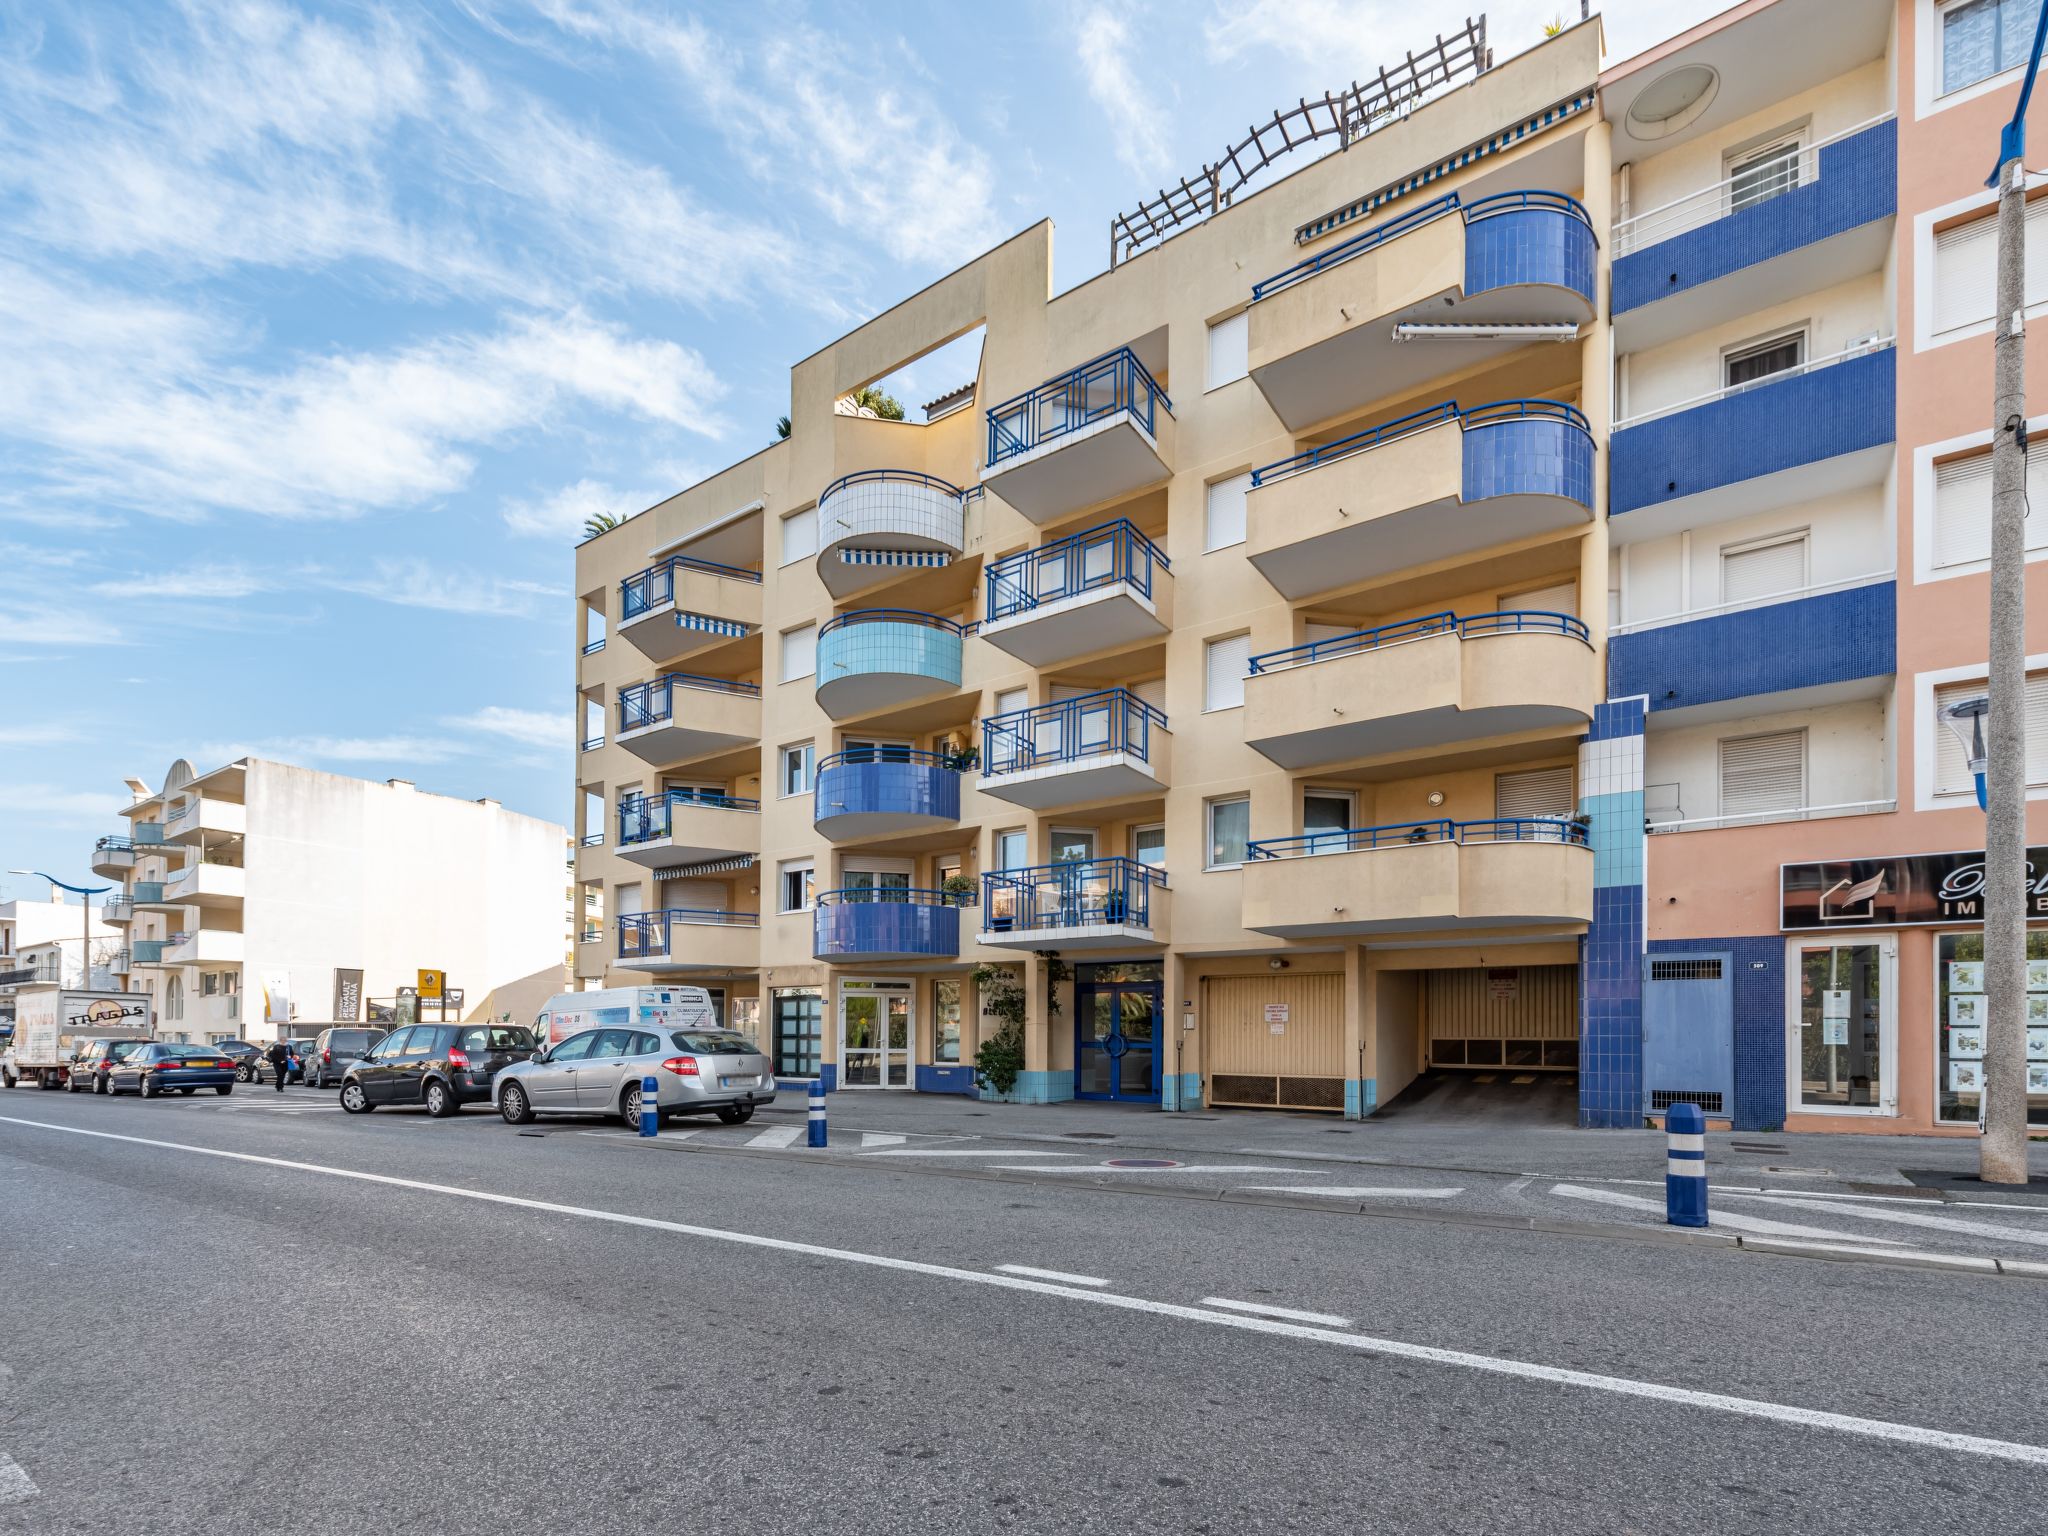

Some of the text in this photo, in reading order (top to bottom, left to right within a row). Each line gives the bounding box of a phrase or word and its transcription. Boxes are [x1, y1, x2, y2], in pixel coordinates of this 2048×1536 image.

[1944, 897, 2048, 915] IMB
[342, 980, 351, 1018] RENAULT
[349, 983, 358, 1019] ARKANA
